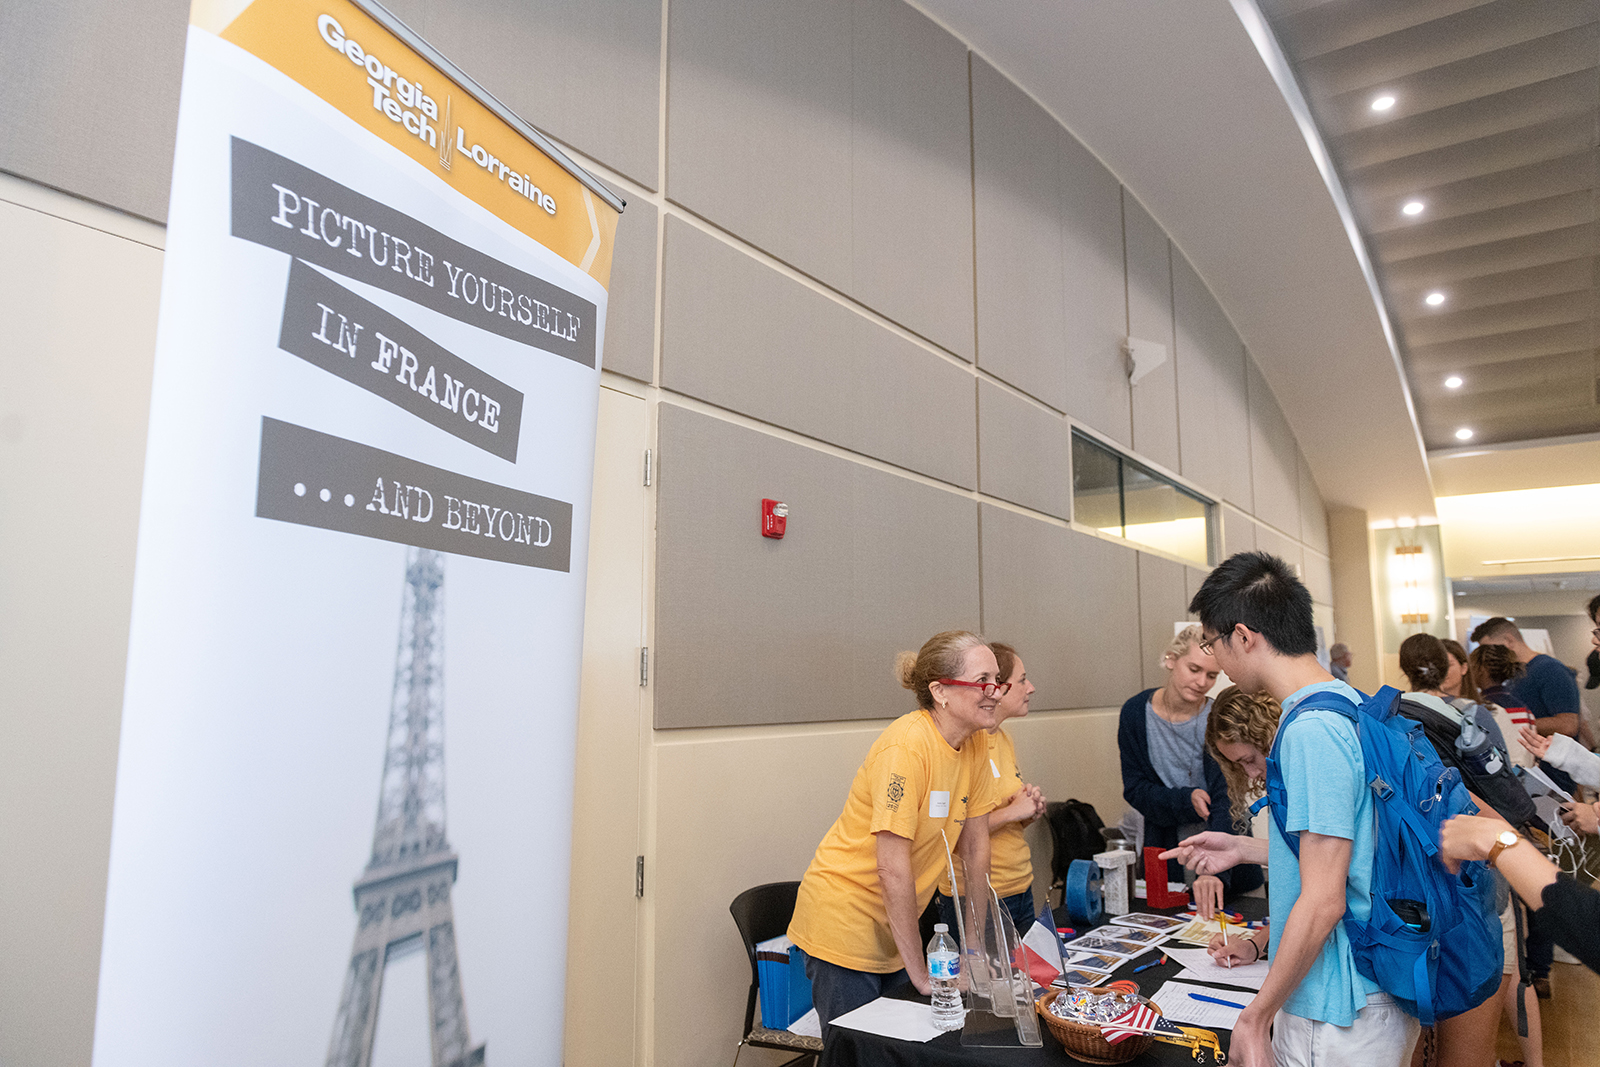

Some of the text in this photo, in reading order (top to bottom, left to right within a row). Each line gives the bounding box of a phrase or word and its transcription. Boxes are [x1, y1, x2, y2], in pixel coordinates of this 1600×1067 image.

[317, 13, 438, 121] Georgia
[366, 78, 437, 149] Tech
[456, 126, 557, 216] Lorraine
[271, 183, 580, 343] PICTURE YOURSELF
[311, 302, 501, 433] IN FRANCE
[366, 477, 433, 523] AND
[441, 496, 552, 548] BEYOND
